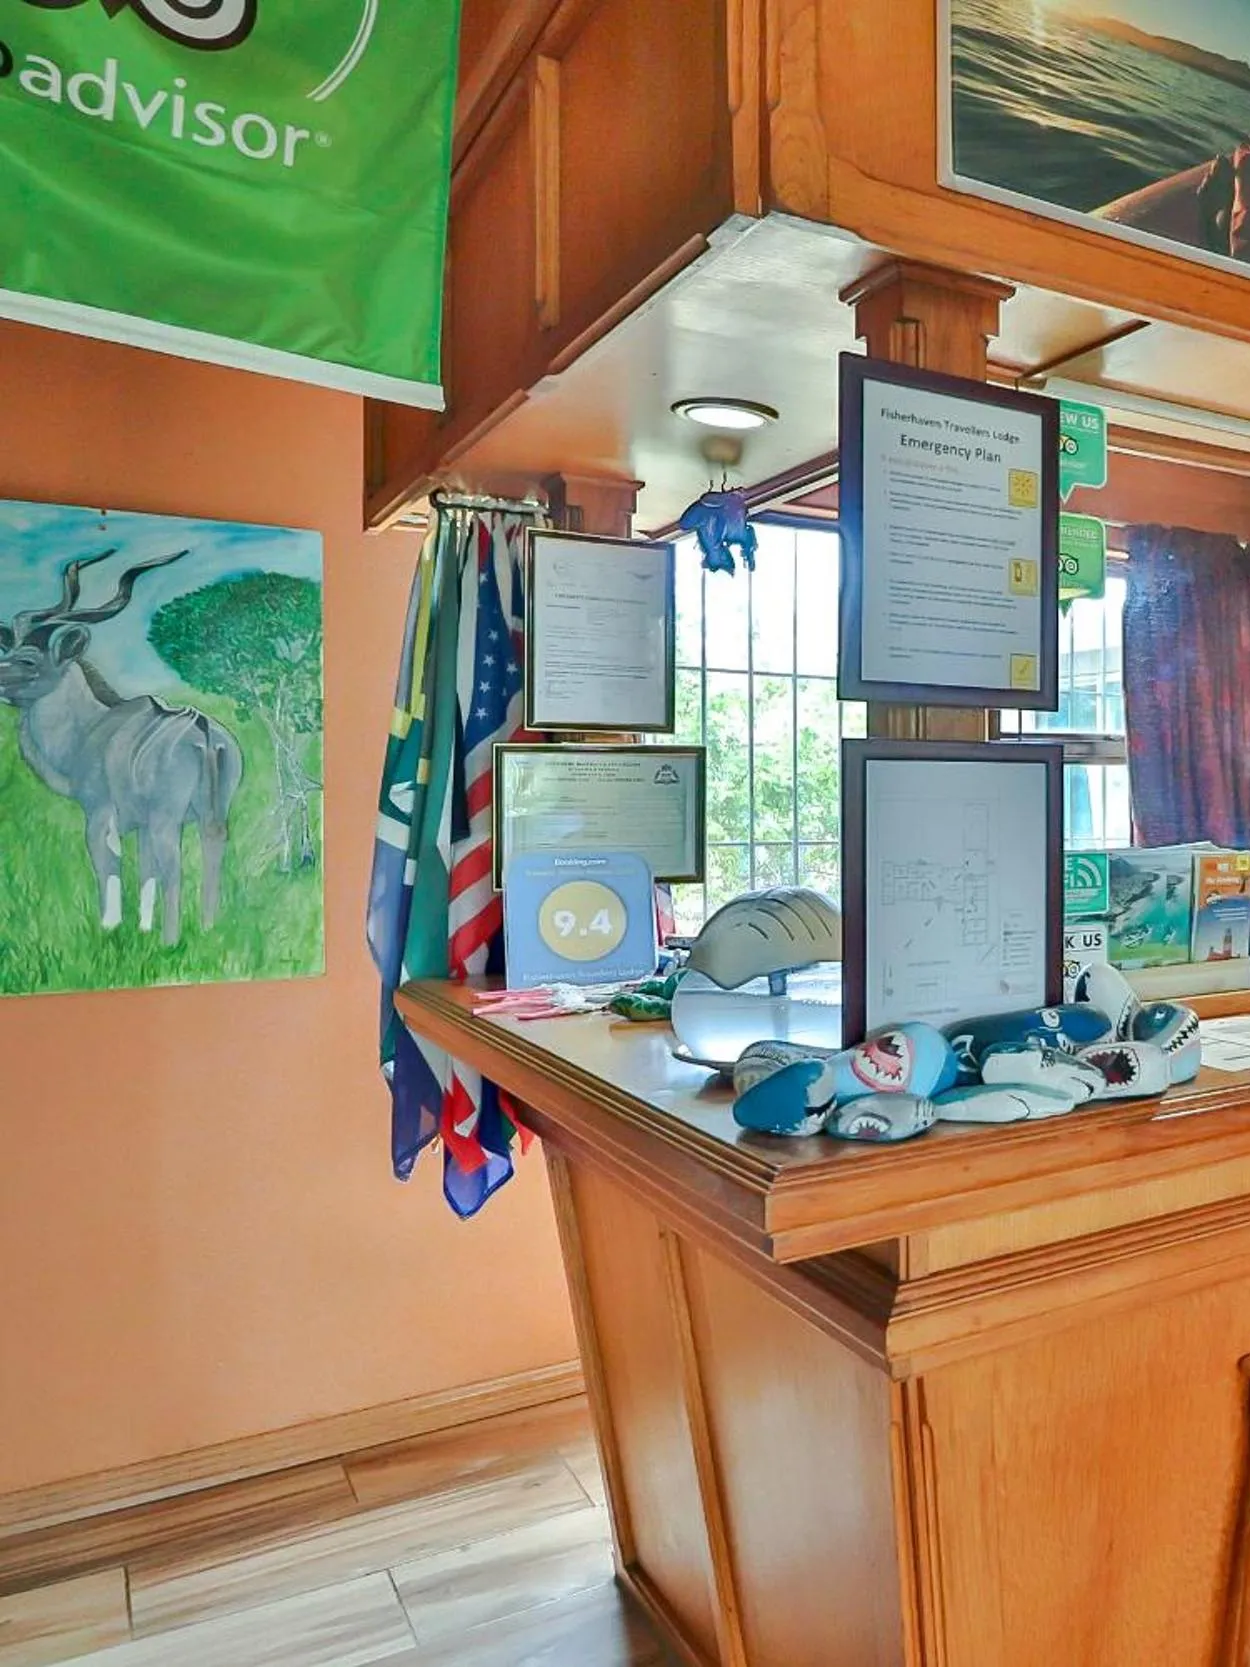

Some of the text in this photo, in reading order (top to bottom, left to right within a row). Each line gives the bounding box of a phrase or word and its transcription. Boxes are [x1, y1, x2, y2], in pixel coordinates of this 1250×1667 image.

[0, 40, 311, 167] advisor
[880, 407, 942, 429] Fisherhaven
[992, 430, 1021, 444] Lodge
[1081, 415, 1099, 430] US
[900, 434, 1001, 463] Emergency Plan
[552, 908, 614, 937] 9.4
[1082, 933, 1102, 947] US
